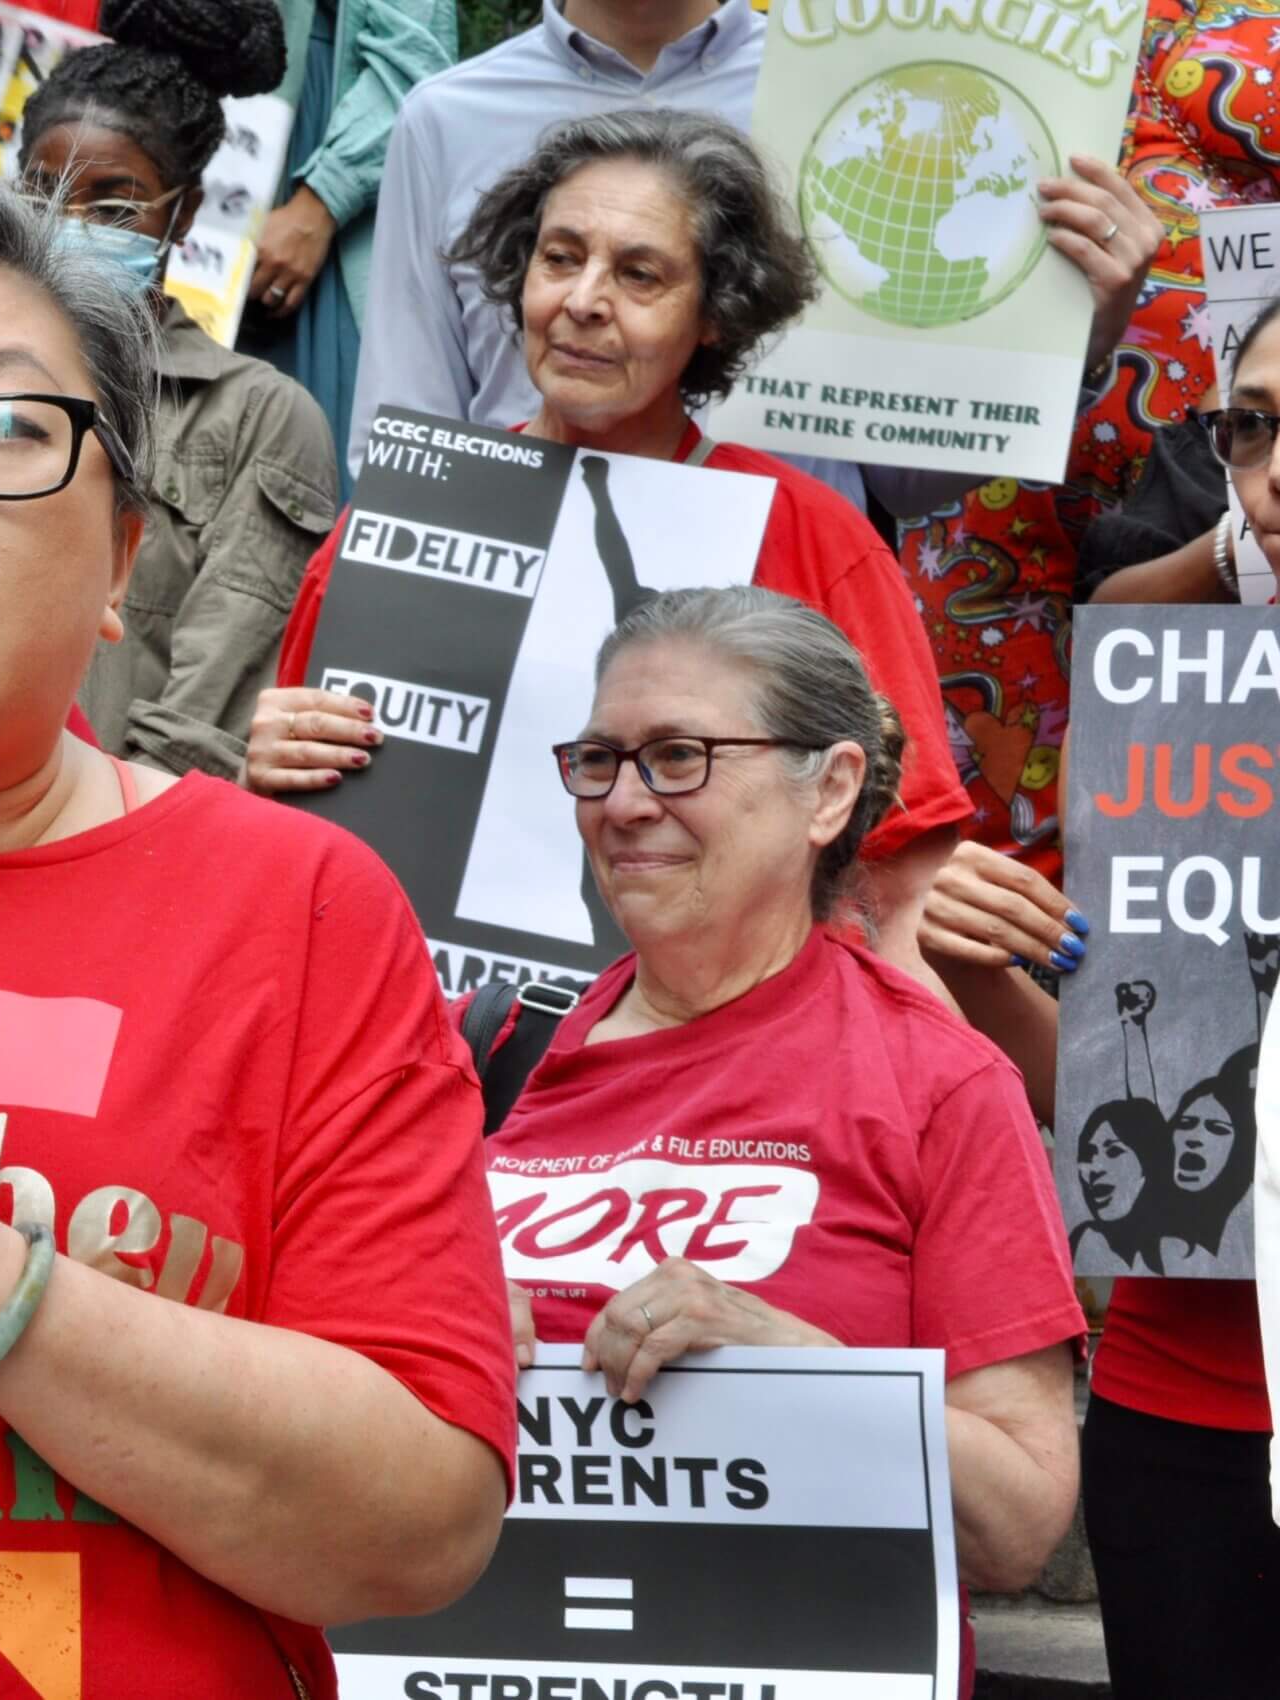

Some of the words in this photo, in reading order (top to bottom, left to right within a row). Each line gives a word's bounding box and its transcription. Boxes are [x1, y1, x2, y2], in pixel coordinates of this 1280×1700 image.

[1208, 232, 1275, 272] WE
[744, 375, 812, 401] THAT
[820, 384, 960, 418] REPRESENT
[969, 399, 1041, 426] THEIR
[372, 416, 430, 443] CCEC
[431, 428, 545, 468] ELECTIONS
[765, 409, 856, 438] ENTIRE
[865, 422, 1011, 454] COMMUNITY
[366, 439, 452, 481] WITH:
[347, 516, 542, 588] FIDELITY
[1094, 742, 1280, 819] JUS
[490, 1155, 582, 1174] MOVEMENT
[588, 1153, 613, 1169] OF
[651, 1134, 664, 1152] &
[668, 1135, 705, 1159] FILE
[709, 1140, 811, 1161] EDUCATORS
[516, 1396, 656, 1448] NYC
